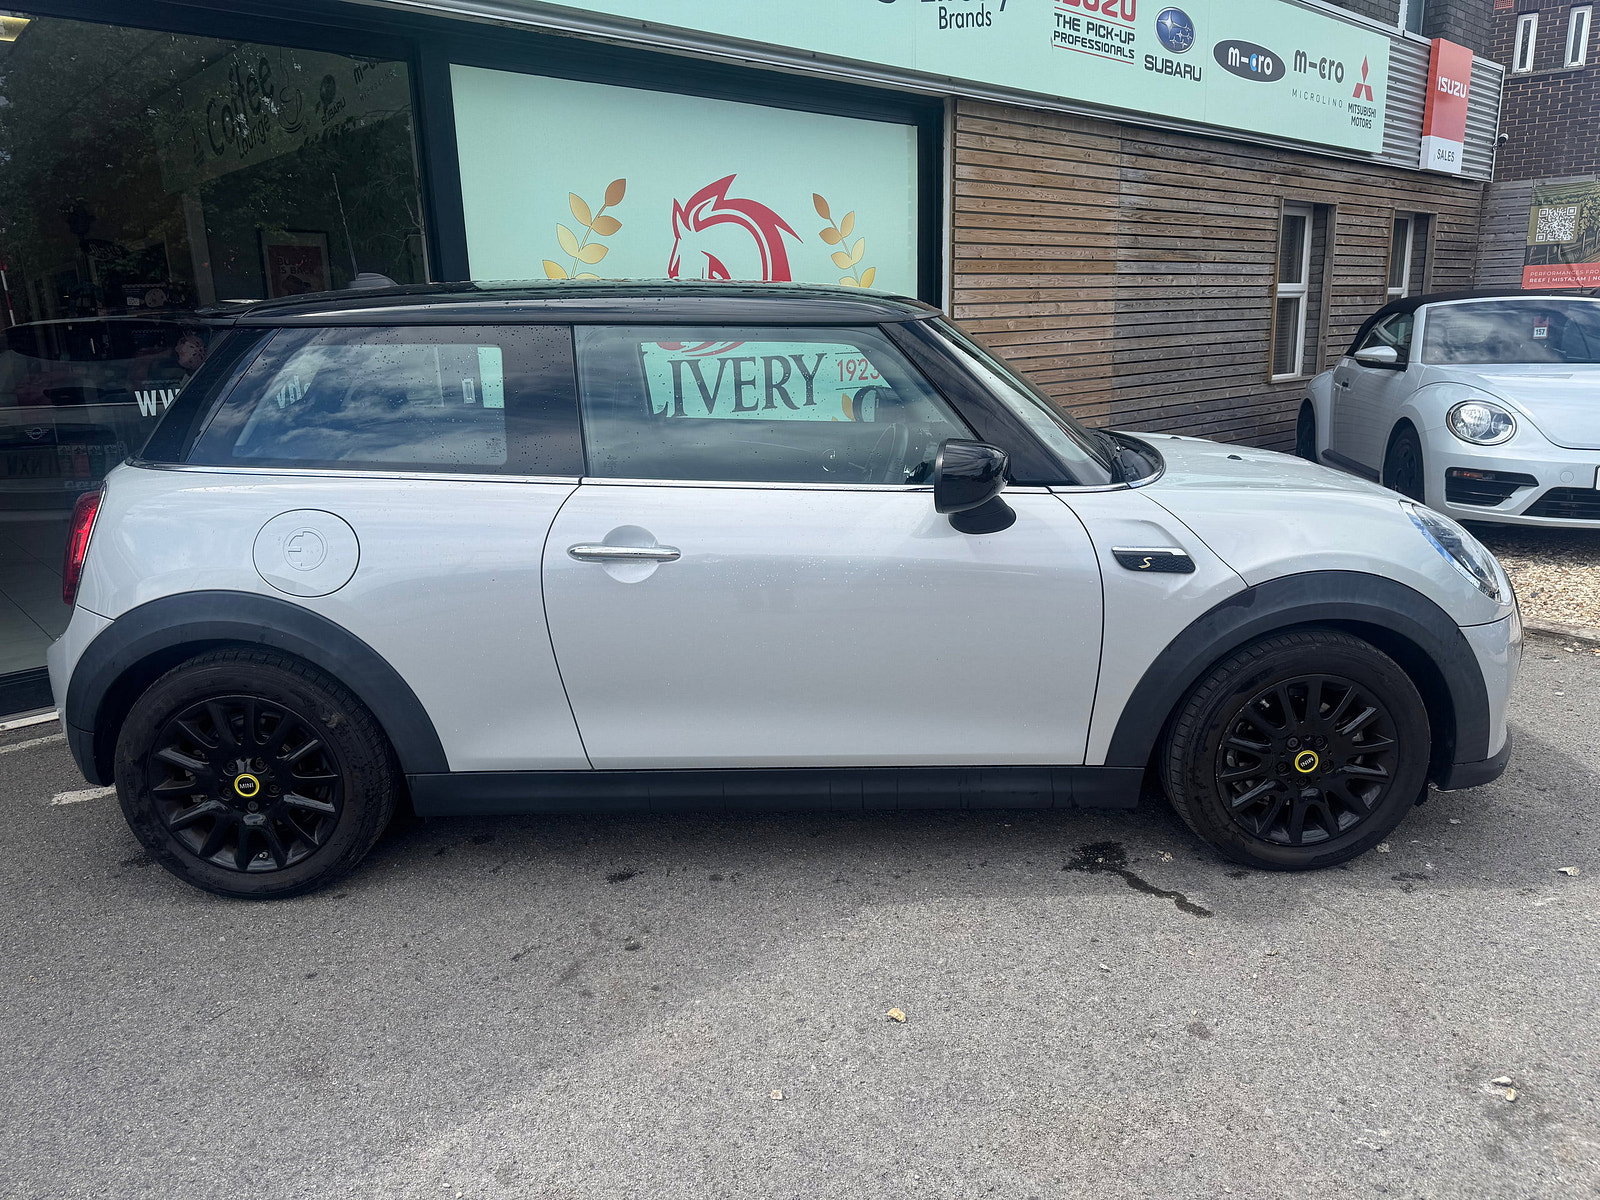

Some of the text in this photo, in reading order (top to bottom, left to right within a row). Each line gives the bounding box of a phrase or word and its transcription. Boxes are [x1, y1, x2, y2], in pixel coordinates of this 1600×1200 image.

[938, 3, 993, 30] Brands
[1054, 13, 1135, 45] THE PICK-UP
[1053, 31, 1135, 60] PROFESSIONALS
[1144, 54, 1202, 83] SUBARU
[1437, 76, 1467, 98] ISUZU
[1291, 88, 1344, 109] MICROLINO
[1347, 102, 1377, 118] MITSUBISHI
[1350, 115, 1373, 130] MOTORS
[1436, 148, 1456, 163] SALES
[1535, 328, 1546, 336] 157
[1138, 556, 1153, 569] S
[239, 781, 254, 789] MINI
